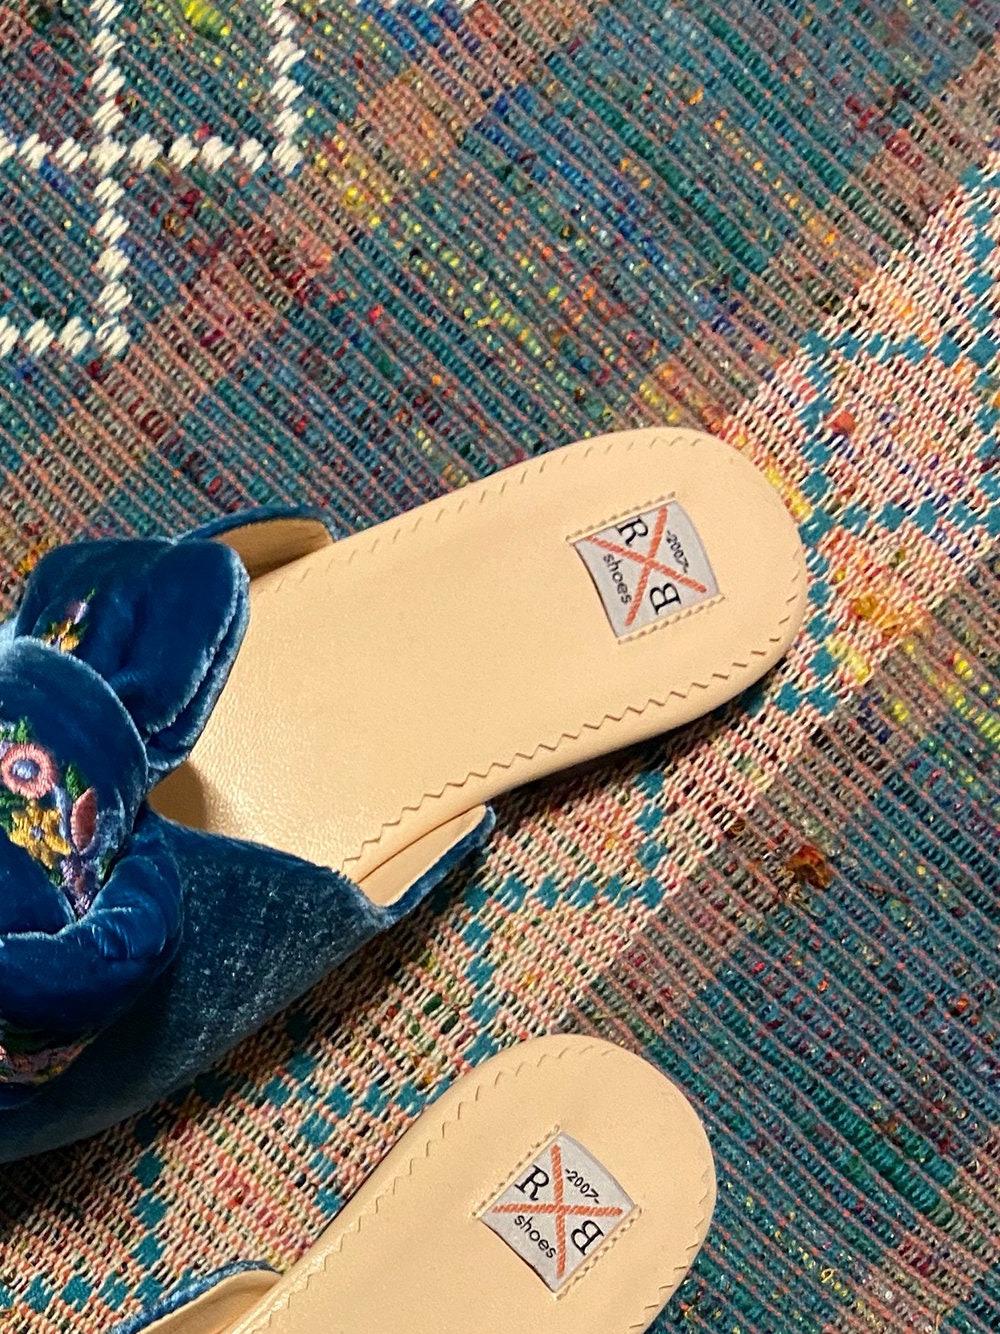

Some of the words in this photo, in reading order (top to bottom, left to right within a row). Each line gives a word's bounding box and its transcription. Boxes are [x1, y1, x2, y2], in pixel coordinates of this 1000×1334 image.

[616, 518, 649, 548] R
[603, 554, 632, 604] shoes
[515, 1165, 549, 1201] R
[514, 1215, 556, 1258] shoes
